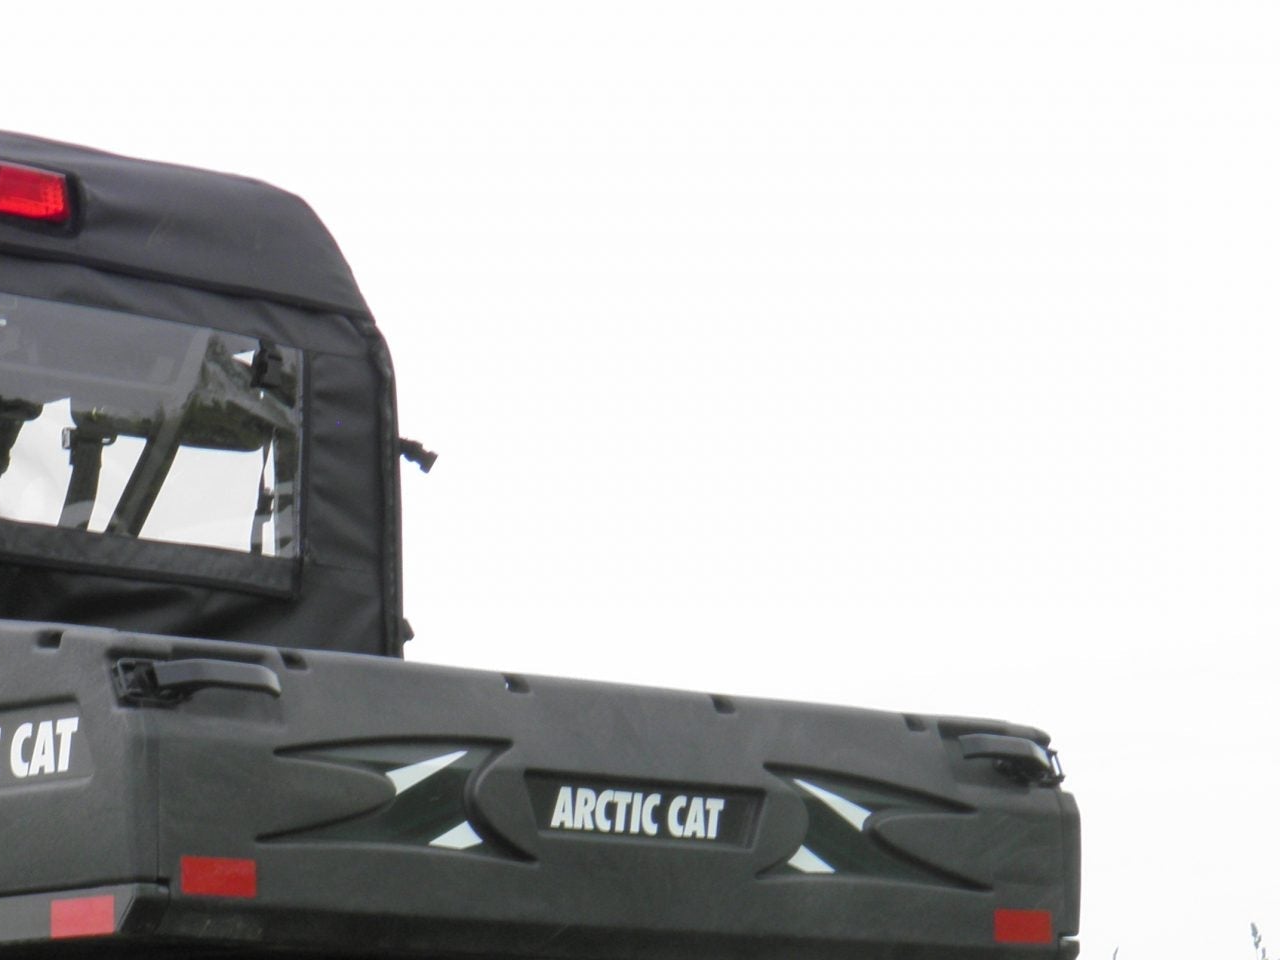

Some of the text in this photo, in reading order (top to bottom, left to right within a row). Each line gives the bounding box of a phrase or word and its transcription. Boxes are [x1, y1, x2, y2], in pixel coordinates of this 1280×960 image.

[9, 716, 80, 779] CAT
[550, 786, 725, 840] ARCTIC CAT
